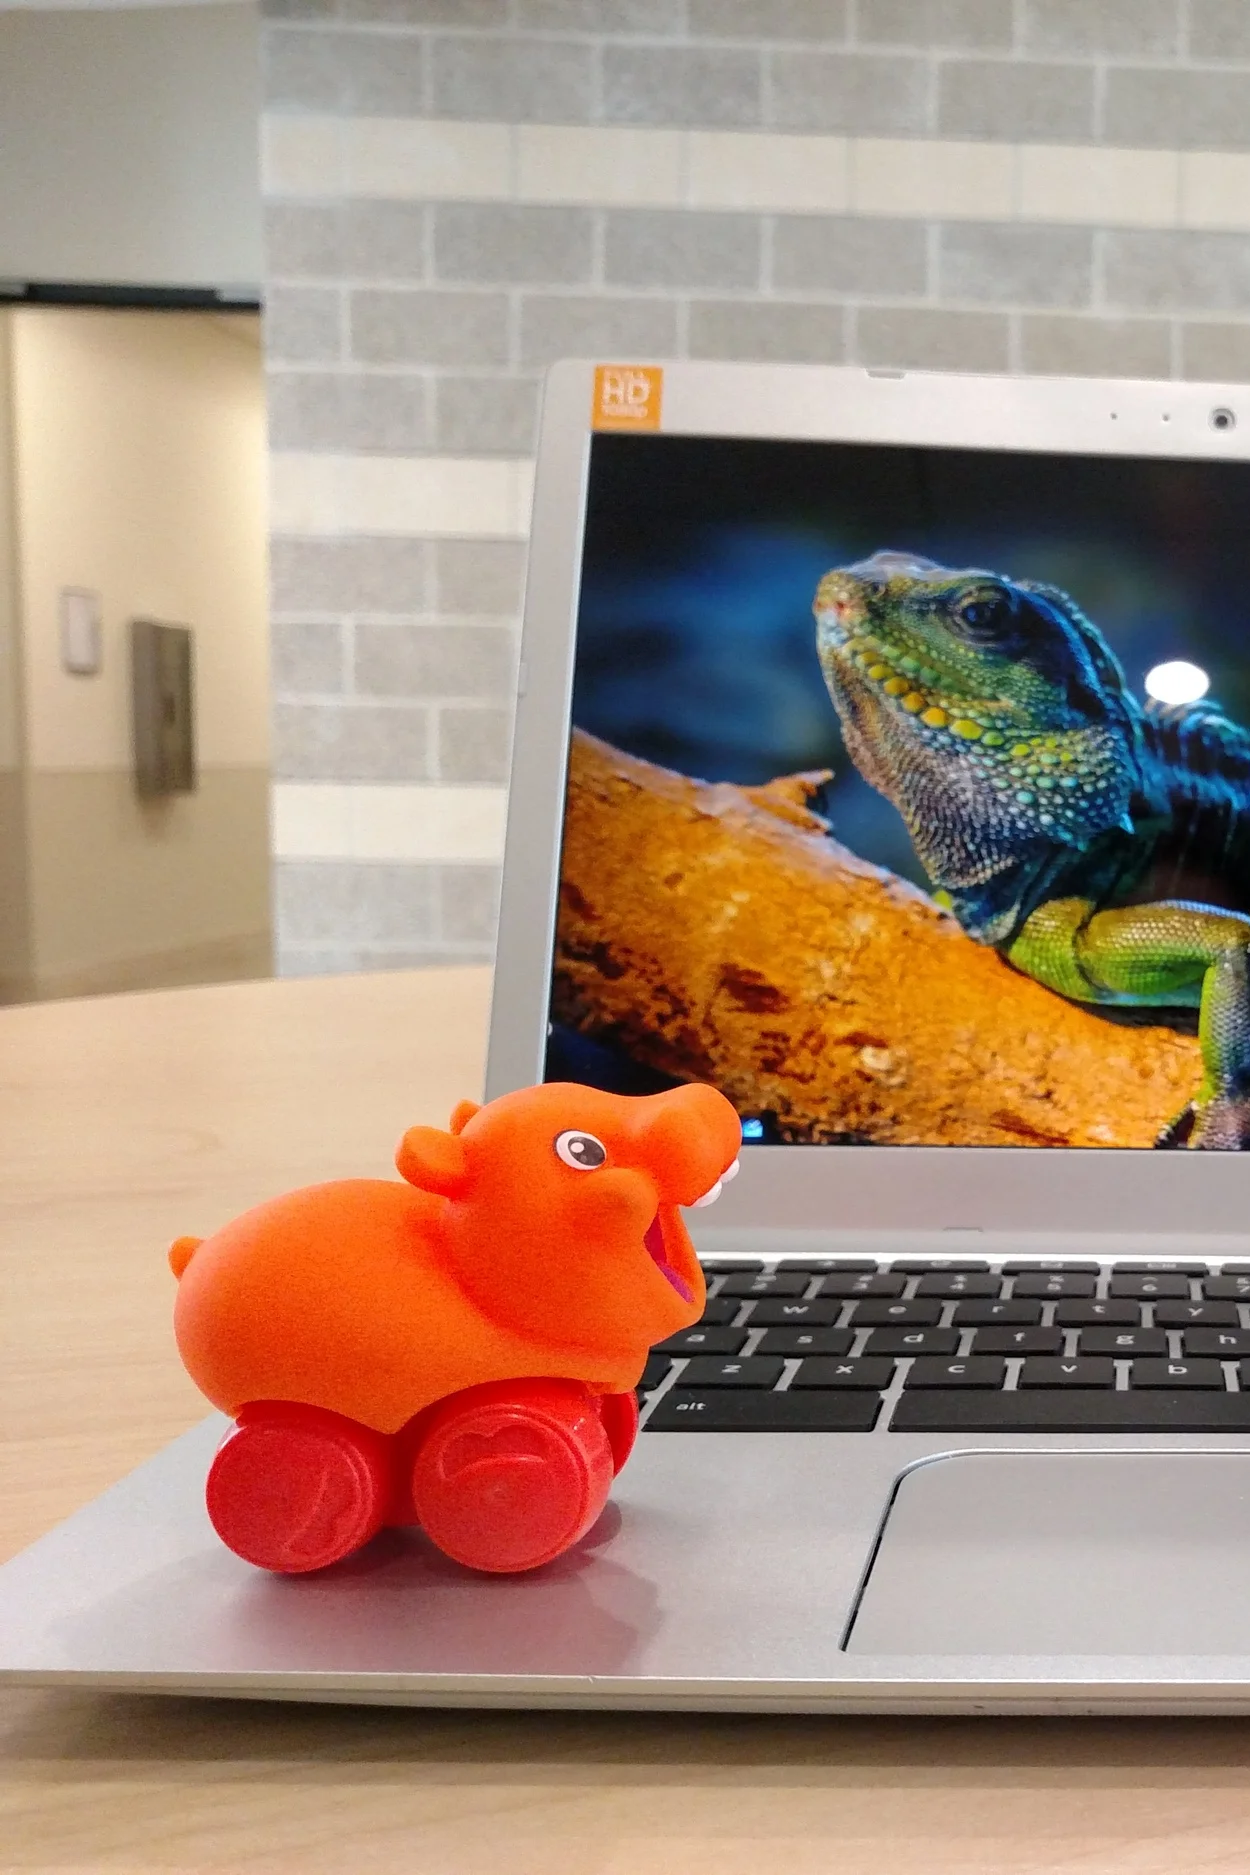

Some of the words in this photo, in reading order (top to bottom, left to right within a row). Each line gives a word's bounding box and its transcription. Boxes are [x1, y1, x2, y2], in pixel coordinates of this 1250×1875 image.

[783, 1305, 809, 1314] w
[888, 1304, 907, 1314] e
[1092, 1303, 1105, 1314] t
[1188, 1307, 1204, 1317] y
[686, 1333, 706, 1343] a
[797, 1334, 814, 1345] s
[903, 1332, 925, 1344] d
[1013, 1331, 1026, 1343] f
[1115, 1334, 1135, 1346] g
[1219, 1333, 1237, 1345] h
[721, 1364, 742, 1374] z
[835, 1365, 855, 1375] x
[948, 1364, 966, 1374] c
[1060, 1364, 1078, 1374] v
[1168, 1363, 1188, 1375] b
[675, 1402, 706, 1411] alt
